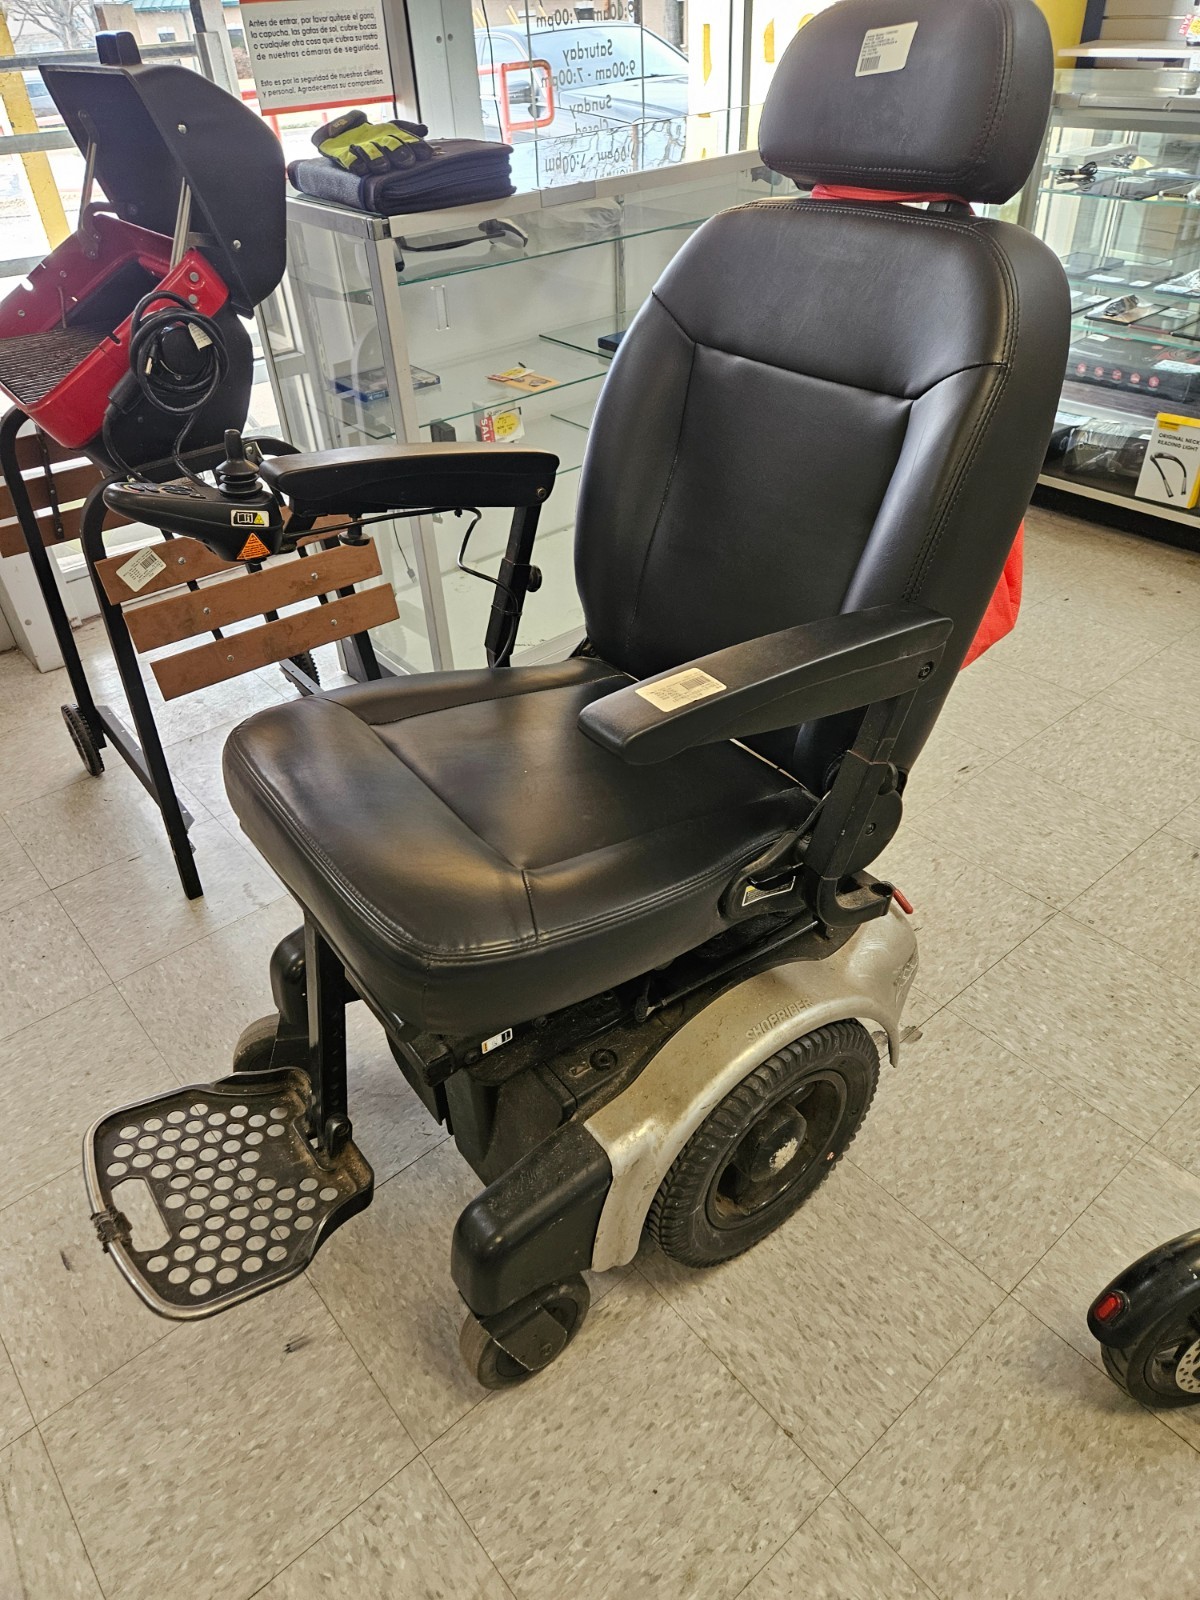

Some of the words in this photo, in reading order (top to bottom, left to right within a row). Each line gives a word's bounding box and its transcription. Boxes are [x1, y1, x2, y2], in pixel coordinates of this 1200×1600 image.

[249, 19, 267, 28] Antes
[269, 18, 278, 26] de
[300, 17, 311, 26] por
[352, 12, 358, 20] el
[250, 30, 258, 39] la
[258, 28, 290, 39] capucha,
[291, 27, 300, 36] las
[320, 25, 328, 34] de
[340, 23, 358, 32] cubre
[359, 22, 377, 31] bocas
[259, 39, 290, 50] cualquier
[291, 38, 305, 47] otra
[305, 37, 321, 46] cosa
[322, 37, 334, 46] que
[335, 34, 354, 43] cubra
[362, 33, 378, 41] rostro
[256, 52, 266, 61] de
[268, 50, 299, 60] nuestras
[333, 46, 343, 54] de
[344, 42, 380, 54] seguridad.
[282, 78, 293, 86] por
[293, 76, 300, 84] la
[300, 74, 329, 84] seguridad
[338, 71, 363, 79] nuestros
[363, 69, 384, 77] clientes
[267, 87, 296, 97] personal.
[297, 83, 339, 95] Agradecemos
[481, 418, 490, 442] SAL
[1158, 432, 1184, 442] ORIGINAL
[1157, 440, 1182, 449] READING
[745, 998, 815, 1041] SHOPRIDER
